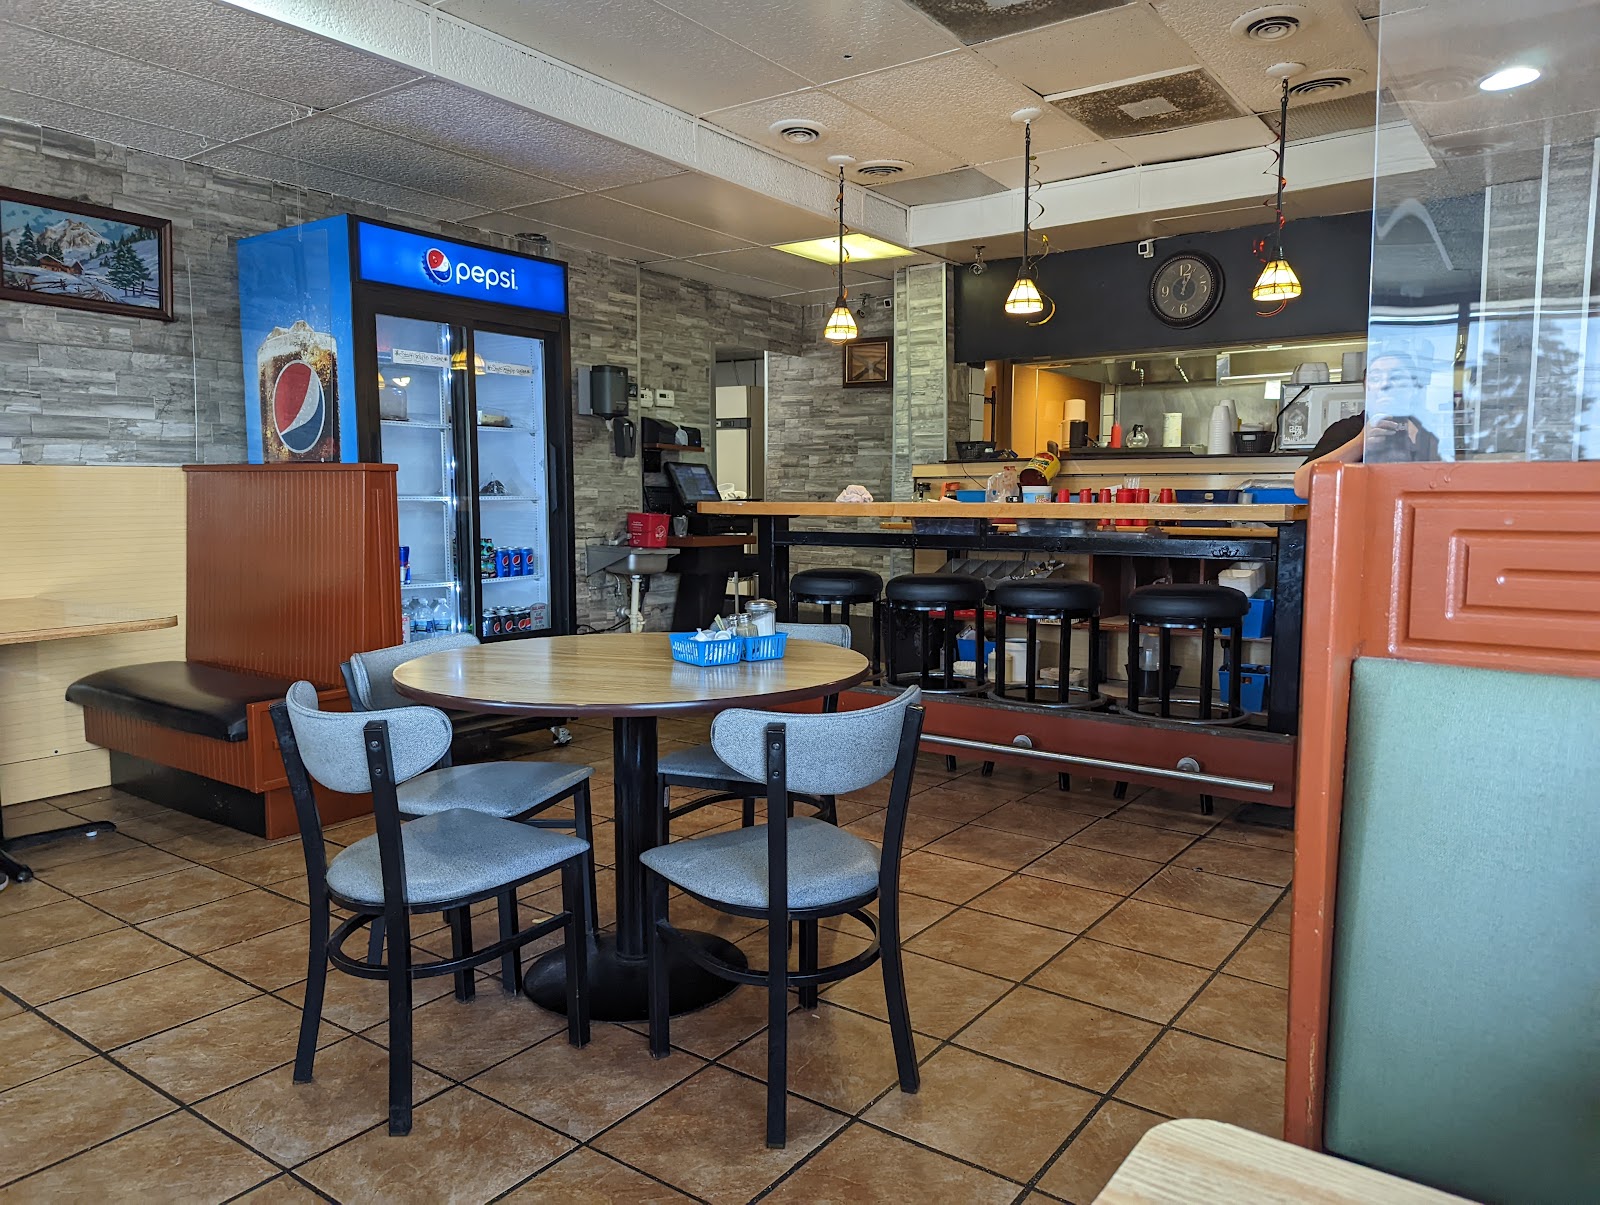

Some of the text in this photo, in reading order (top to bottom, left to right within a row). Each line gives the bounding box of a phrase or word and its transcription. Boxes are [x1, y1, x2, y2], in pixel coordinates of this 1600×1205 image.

[1180, 264, 1191, 276] 12
[456, 262, 516, 290] pepsi
[1161, 286, 1169, 297] 9
[1180, 303, 1187, 314] 6
